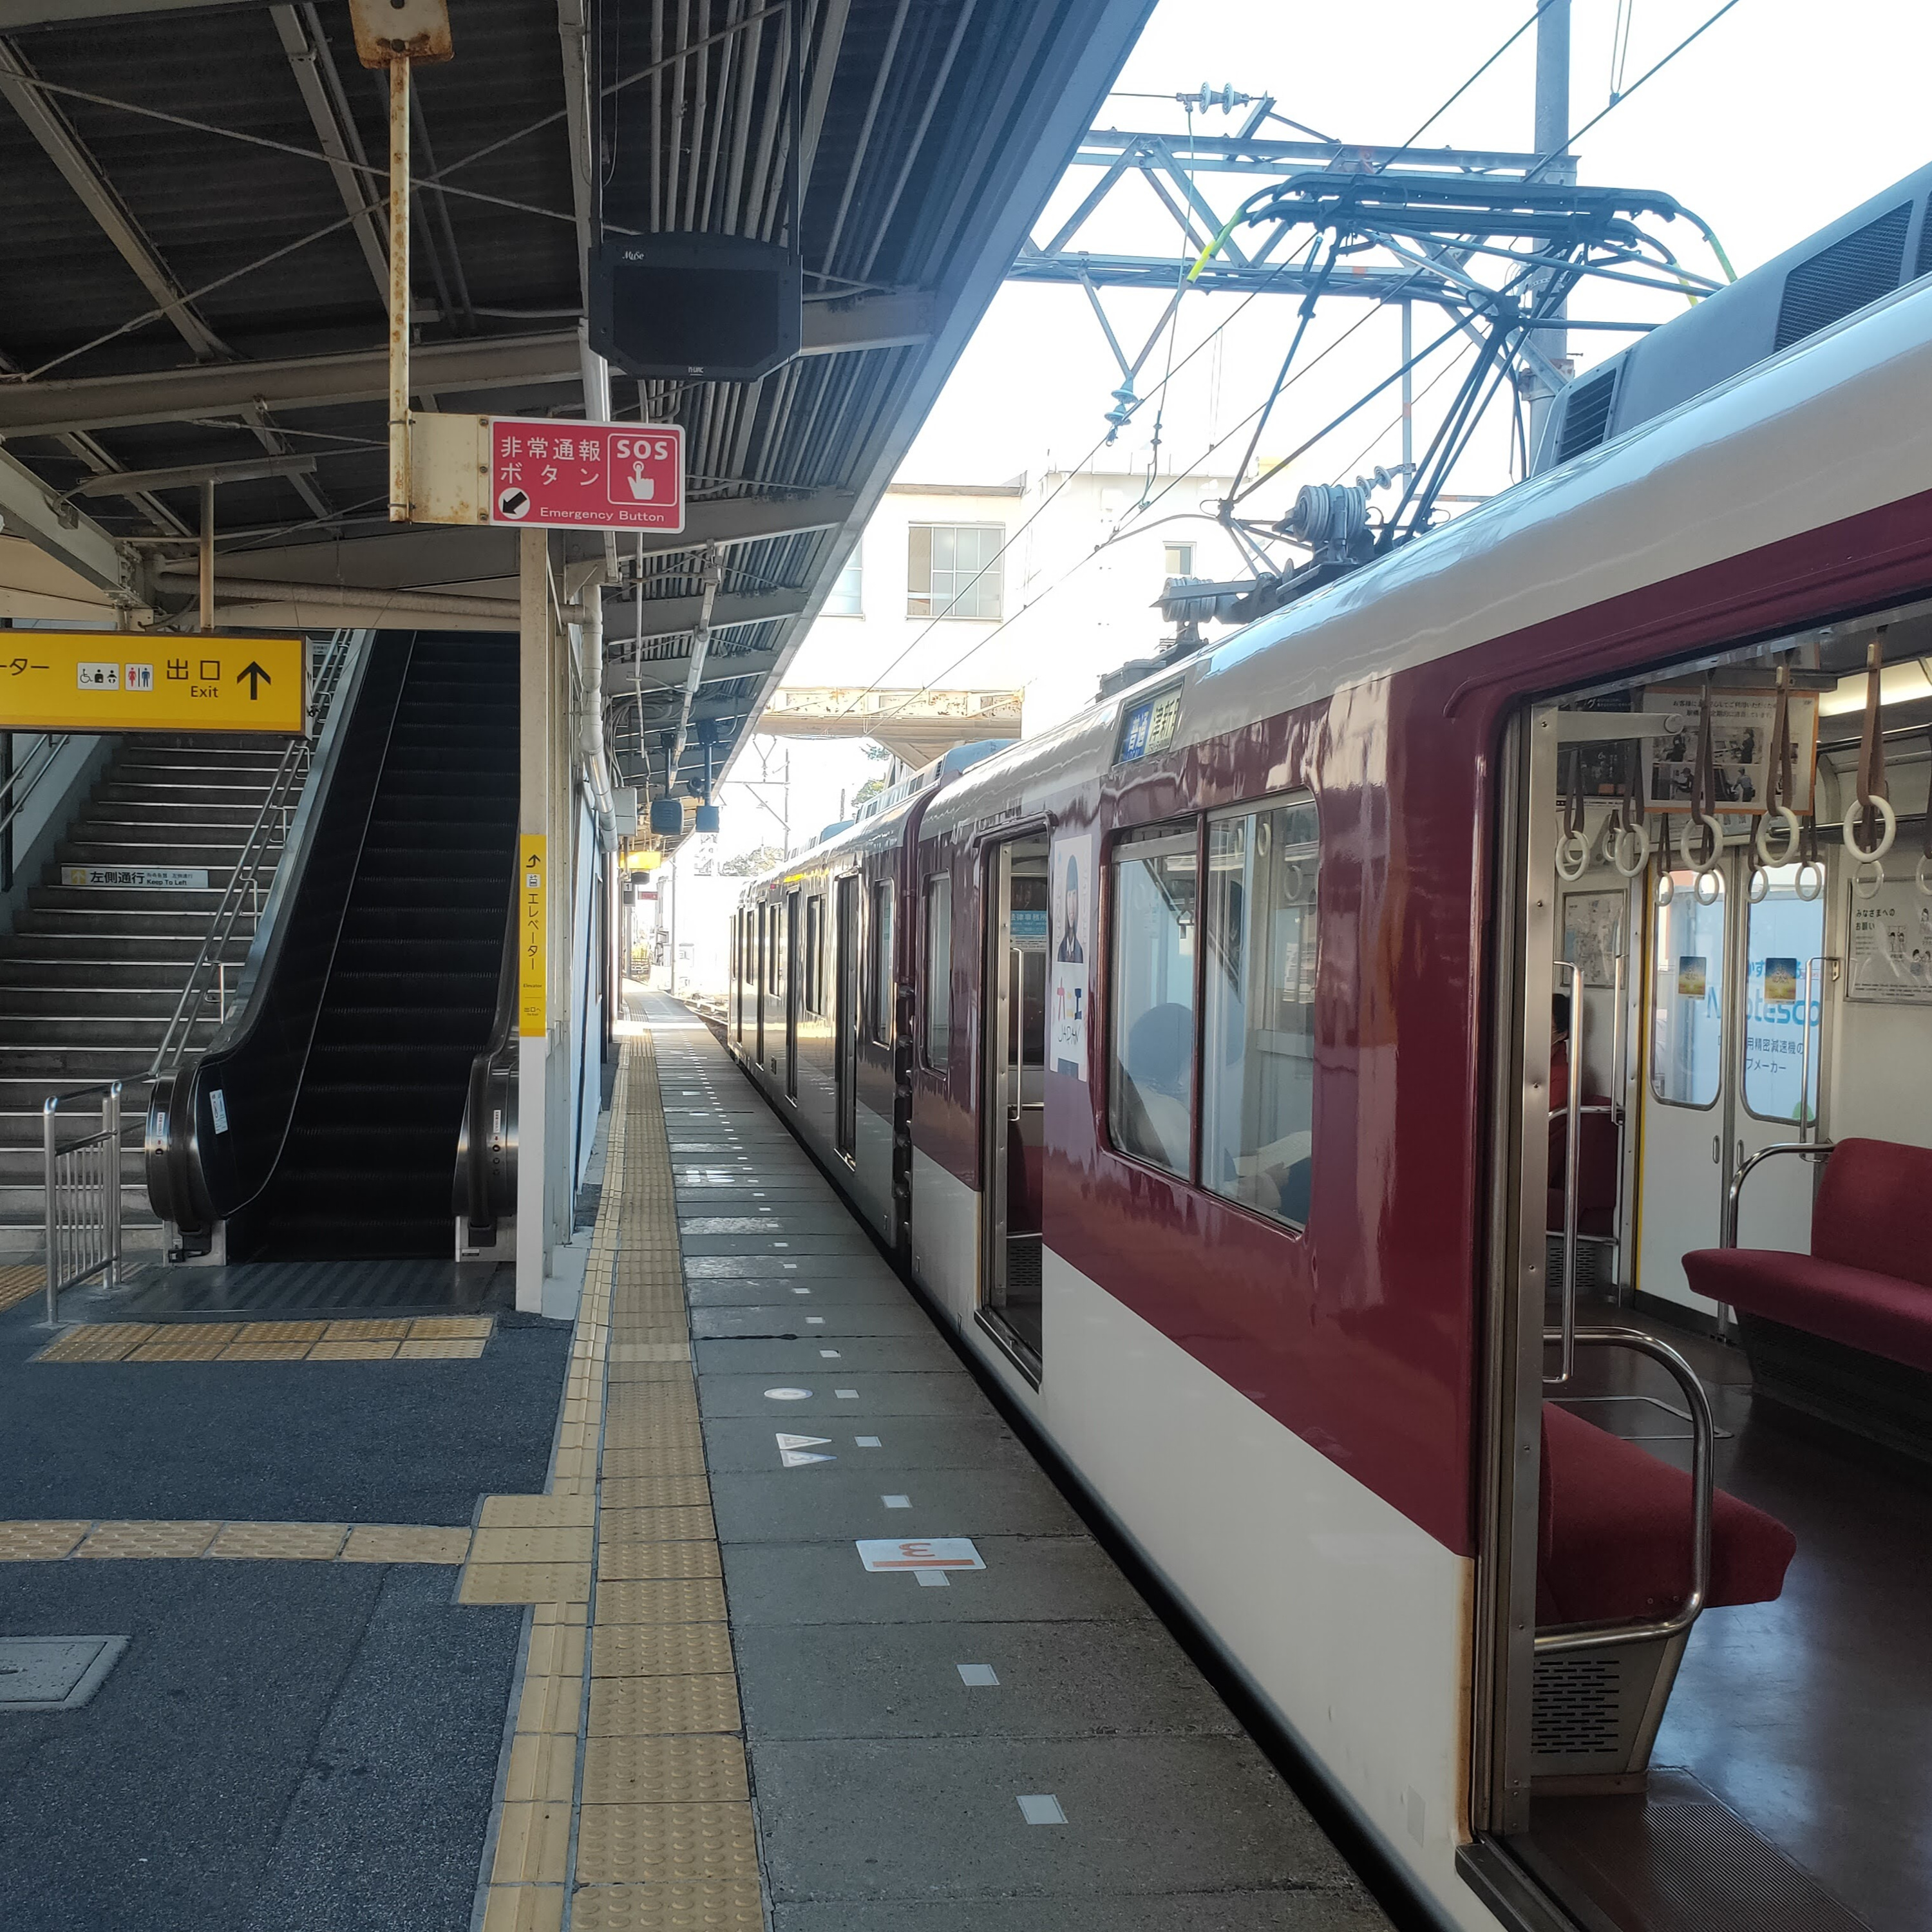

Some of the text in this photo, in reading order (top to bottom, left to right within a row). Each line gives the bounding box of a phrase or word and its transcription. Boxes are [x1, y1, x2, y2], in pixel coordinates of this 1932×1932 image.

[500, 436, 601, 462] 非常通報
[616, 439, 668, 460] SOS
[500, 462, 600, 486] ボタン
[540, 507, 665, 522] Emergency Button
[167, 658, 220, 681] 出口
[191, 686, 218, 698] Exit
[90, 871, 145, 885] 左側通行
[1856, 908, 1896, 918] みなさまへの
[527, 893, 539, 971] エレベーター
[898, 1542, 936, 1558] 3
